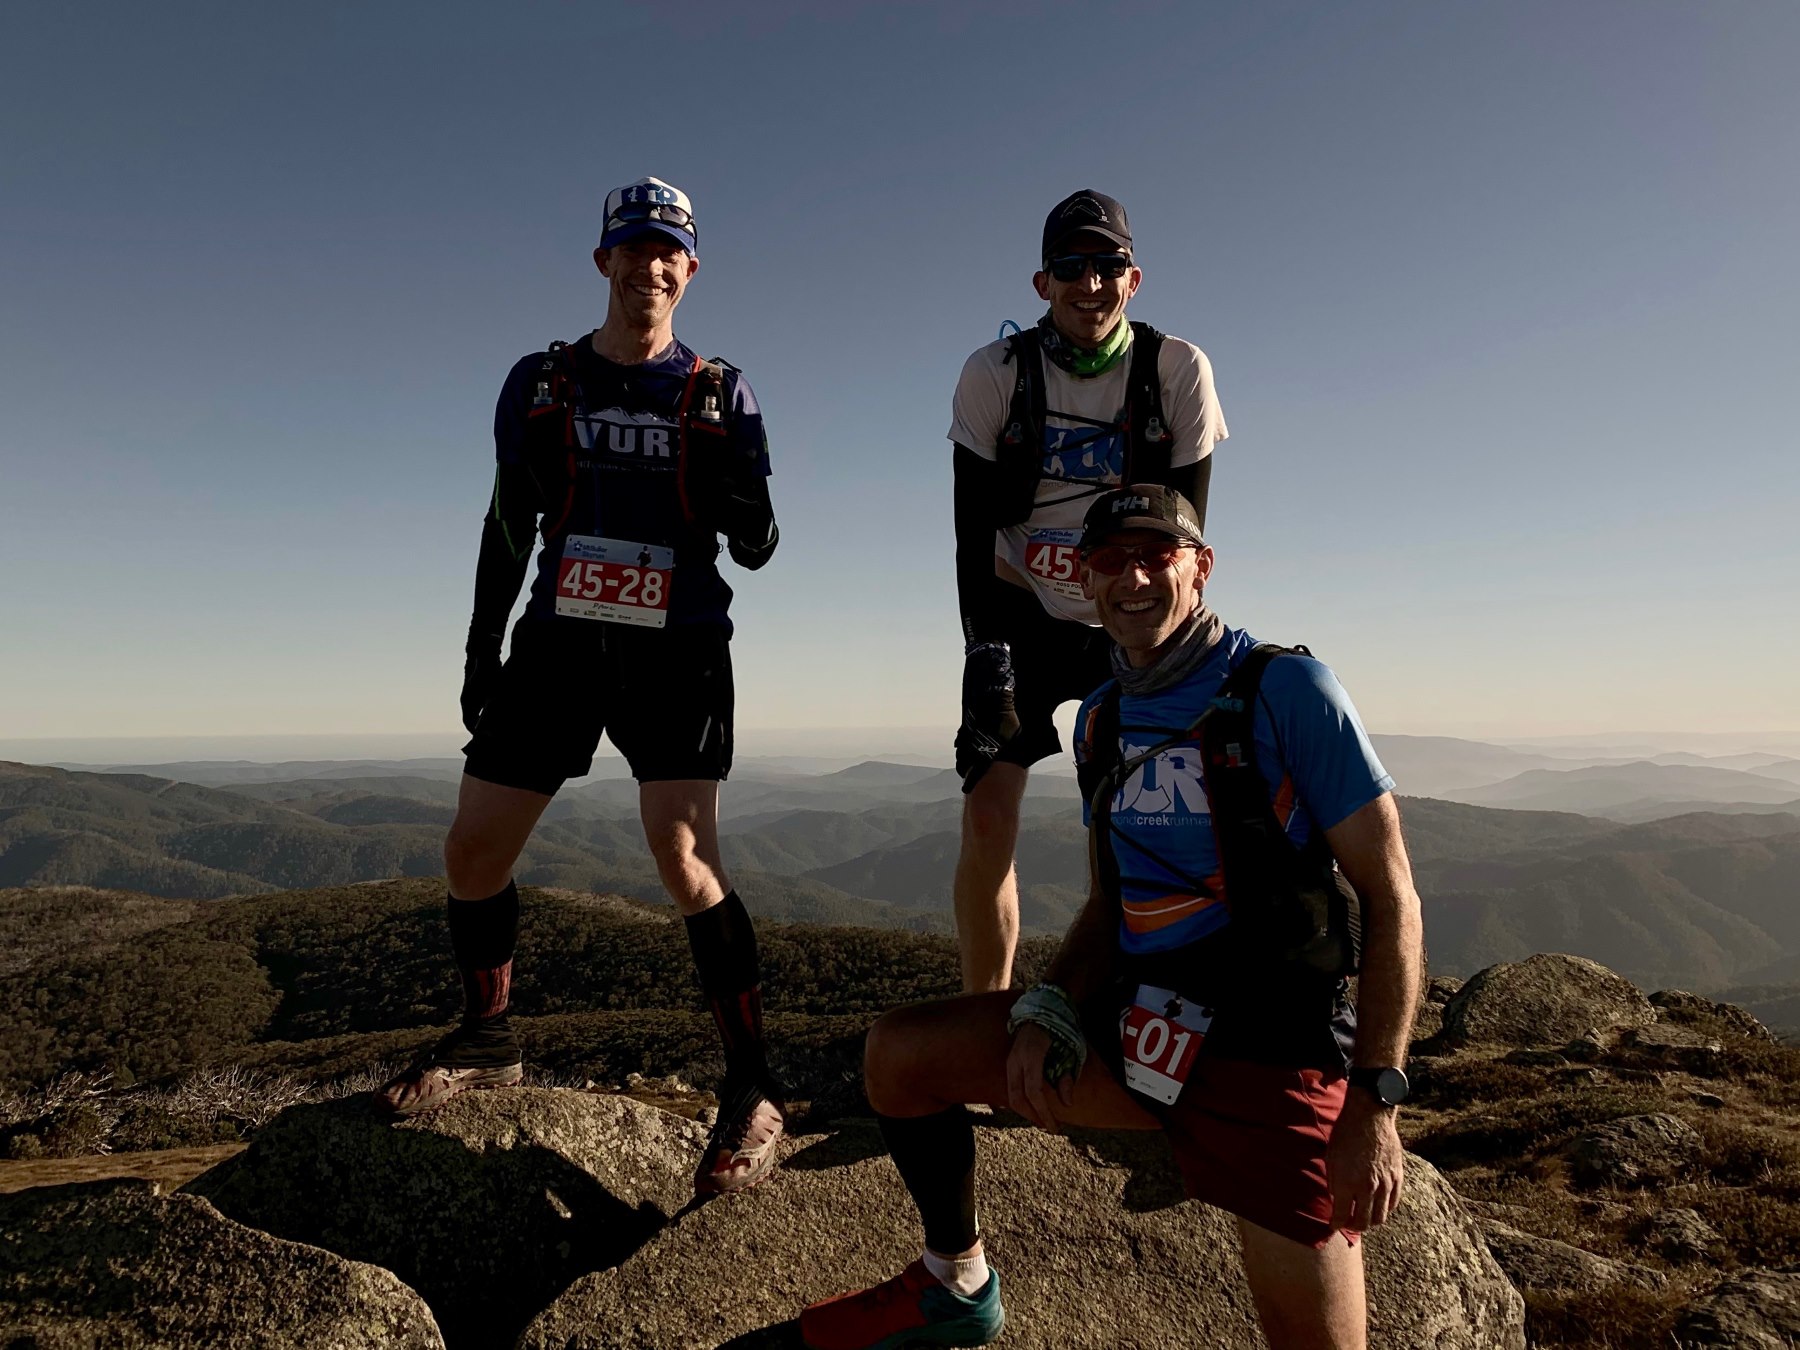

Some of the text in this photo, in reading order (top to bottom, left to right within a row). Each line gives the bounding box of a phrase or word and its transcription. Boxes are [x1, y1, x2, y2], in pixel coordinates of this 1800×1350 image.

[574, 421, 680, 458] VUR
[1111, 496, 1150, 514] HH
[562, 561, 663, 607] 45-28
